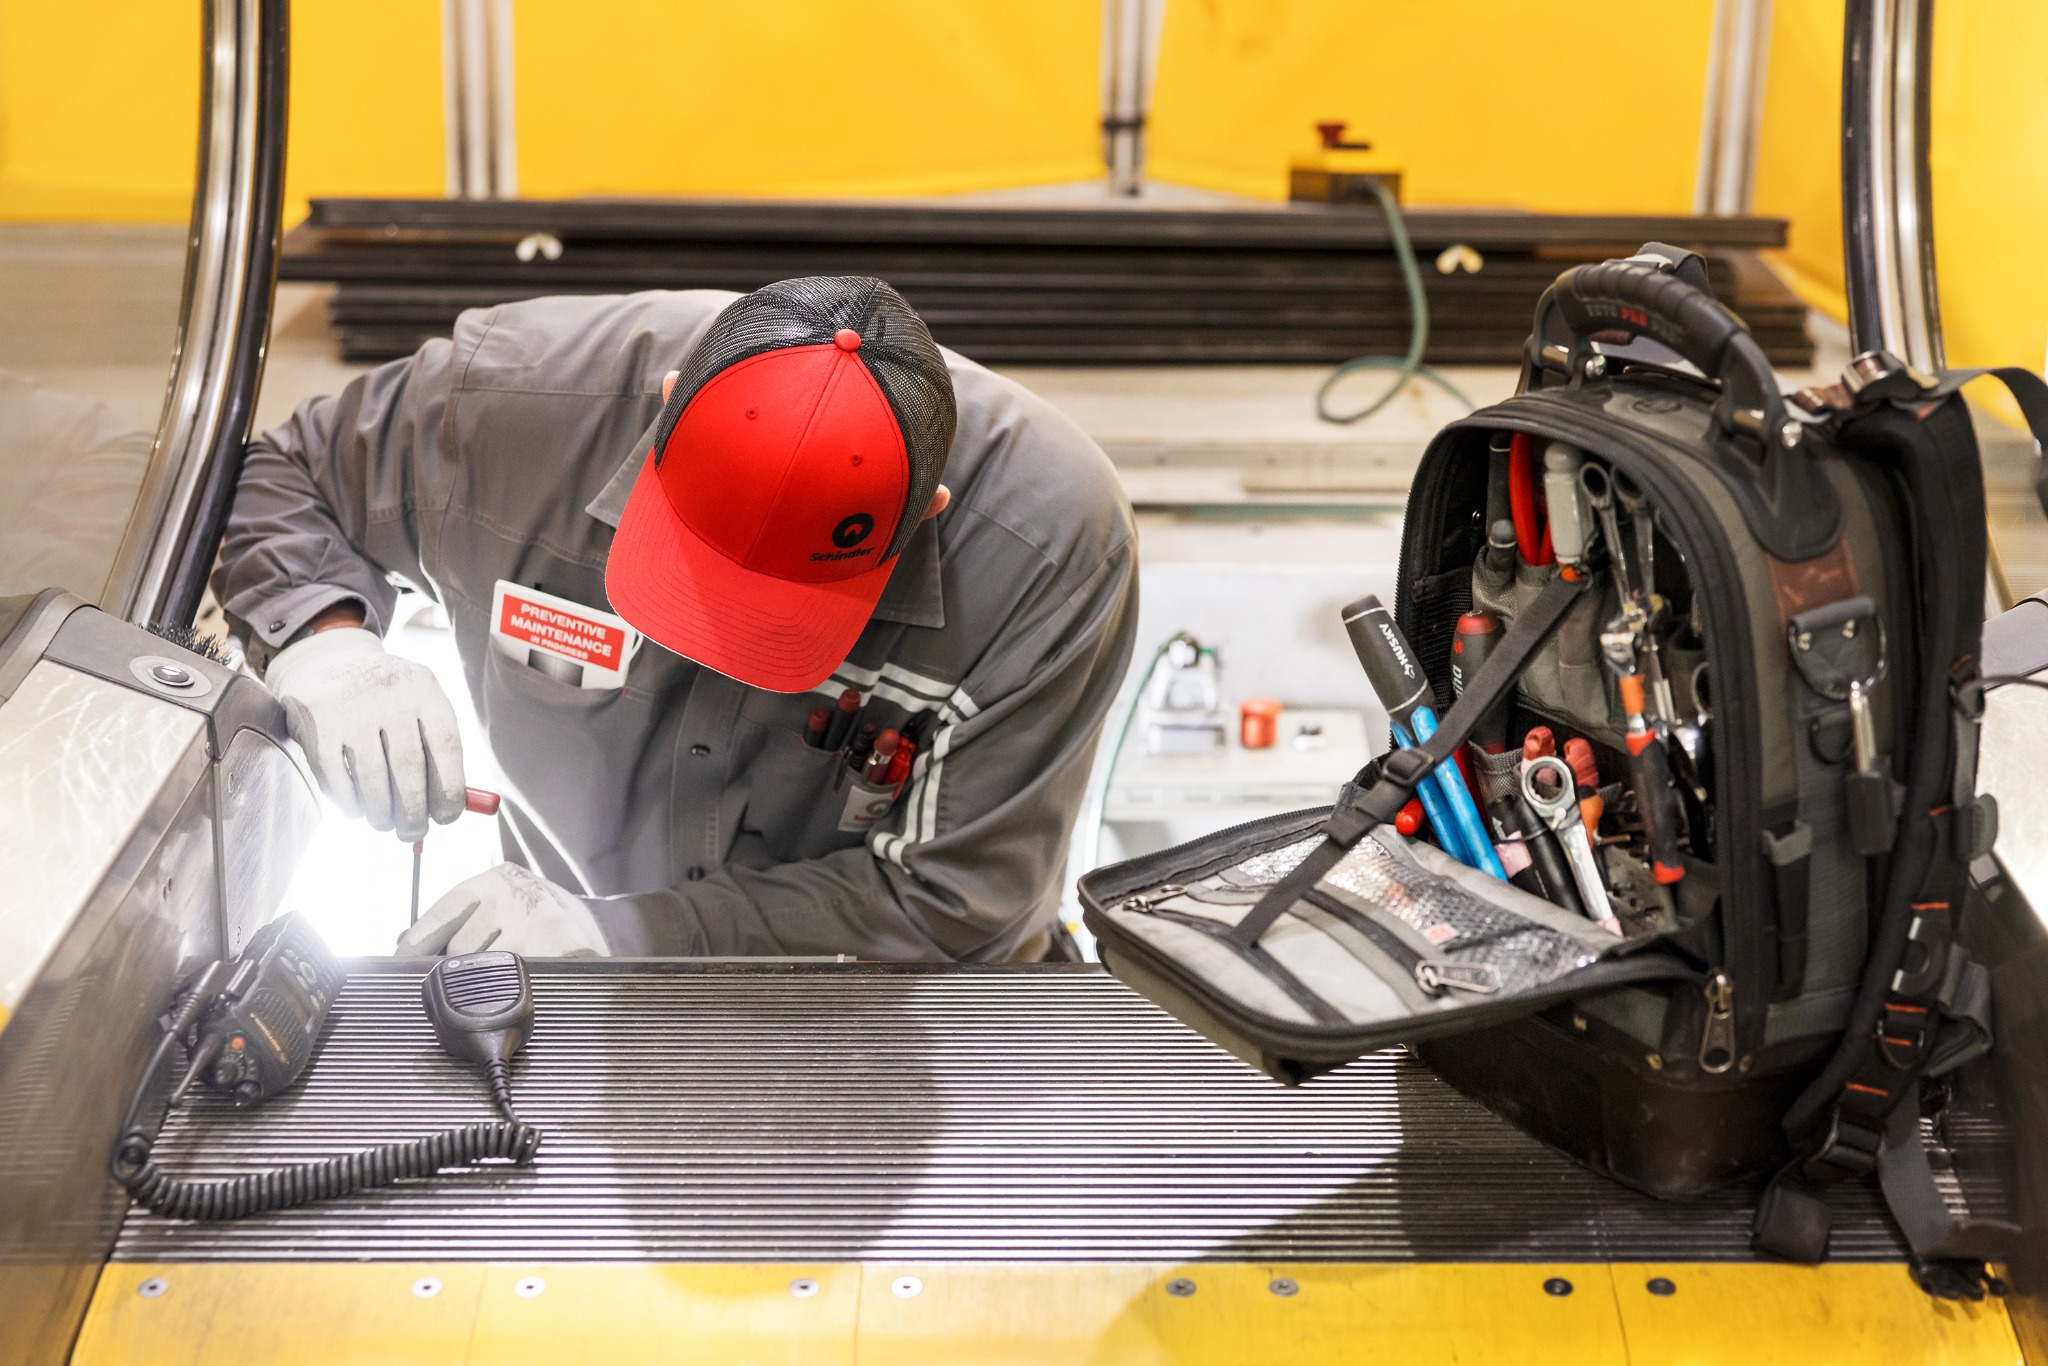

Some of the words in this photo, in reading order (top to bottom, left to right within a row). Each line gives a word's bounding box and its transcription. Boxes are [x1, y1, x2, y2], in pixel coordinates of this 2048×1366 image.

[809, 547, 875, 562] Schindler
[510, 613, 613, 658] MAINTENANCE
[520, 602, 607, 640] PREVENTIVE
[1379, 623, 1409, 666] HUSKY
